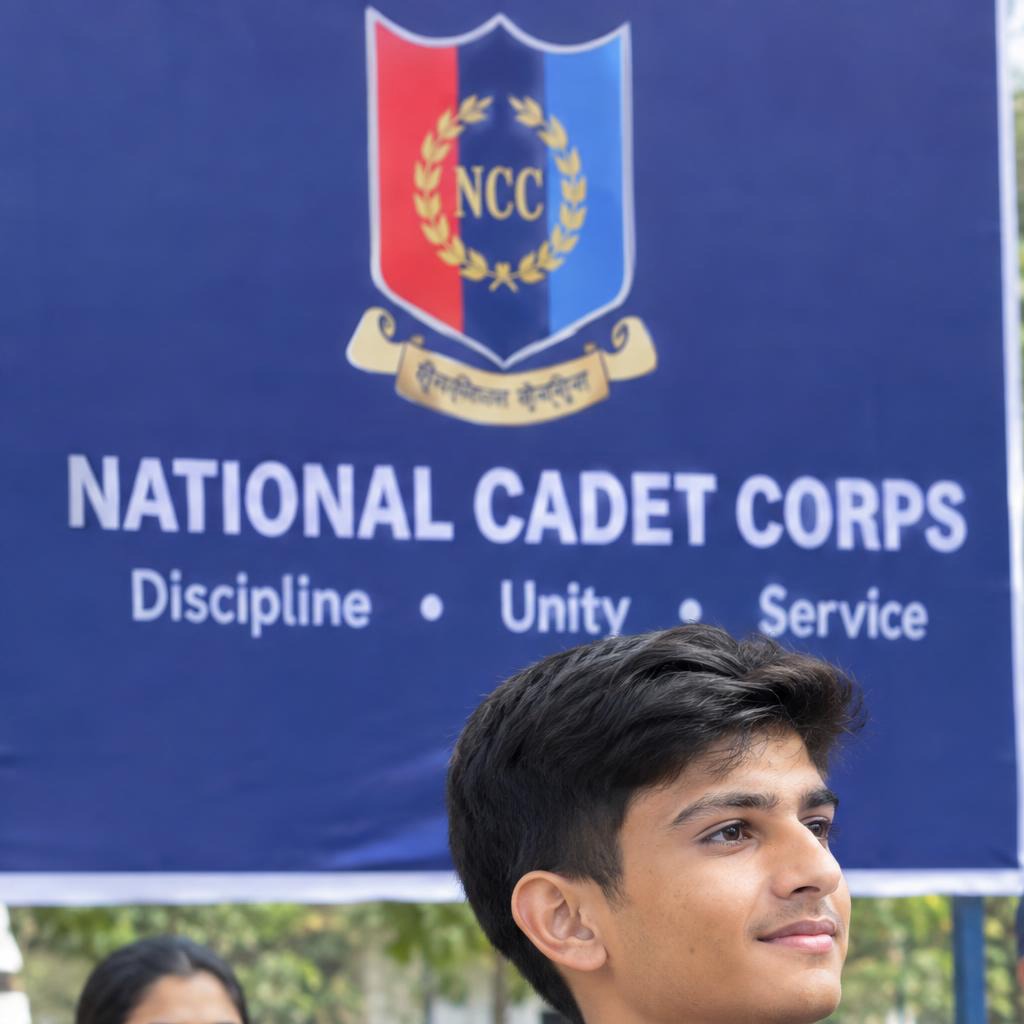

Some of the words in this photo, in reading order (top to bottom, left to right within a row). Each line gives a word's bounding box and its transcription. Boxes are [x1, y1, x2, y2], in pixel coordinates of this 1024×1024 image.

[454, 165, 545, 221] NCC
[67, 455, 454, 541] NATIONAL
[473, 467, 718, 546] CADET
[735, 475, 967, 553] CORPS
[131, 569, 372, 638] Discipline
[501, 579, 631, 637] Unity
[758, 584, 928, 641] Service
